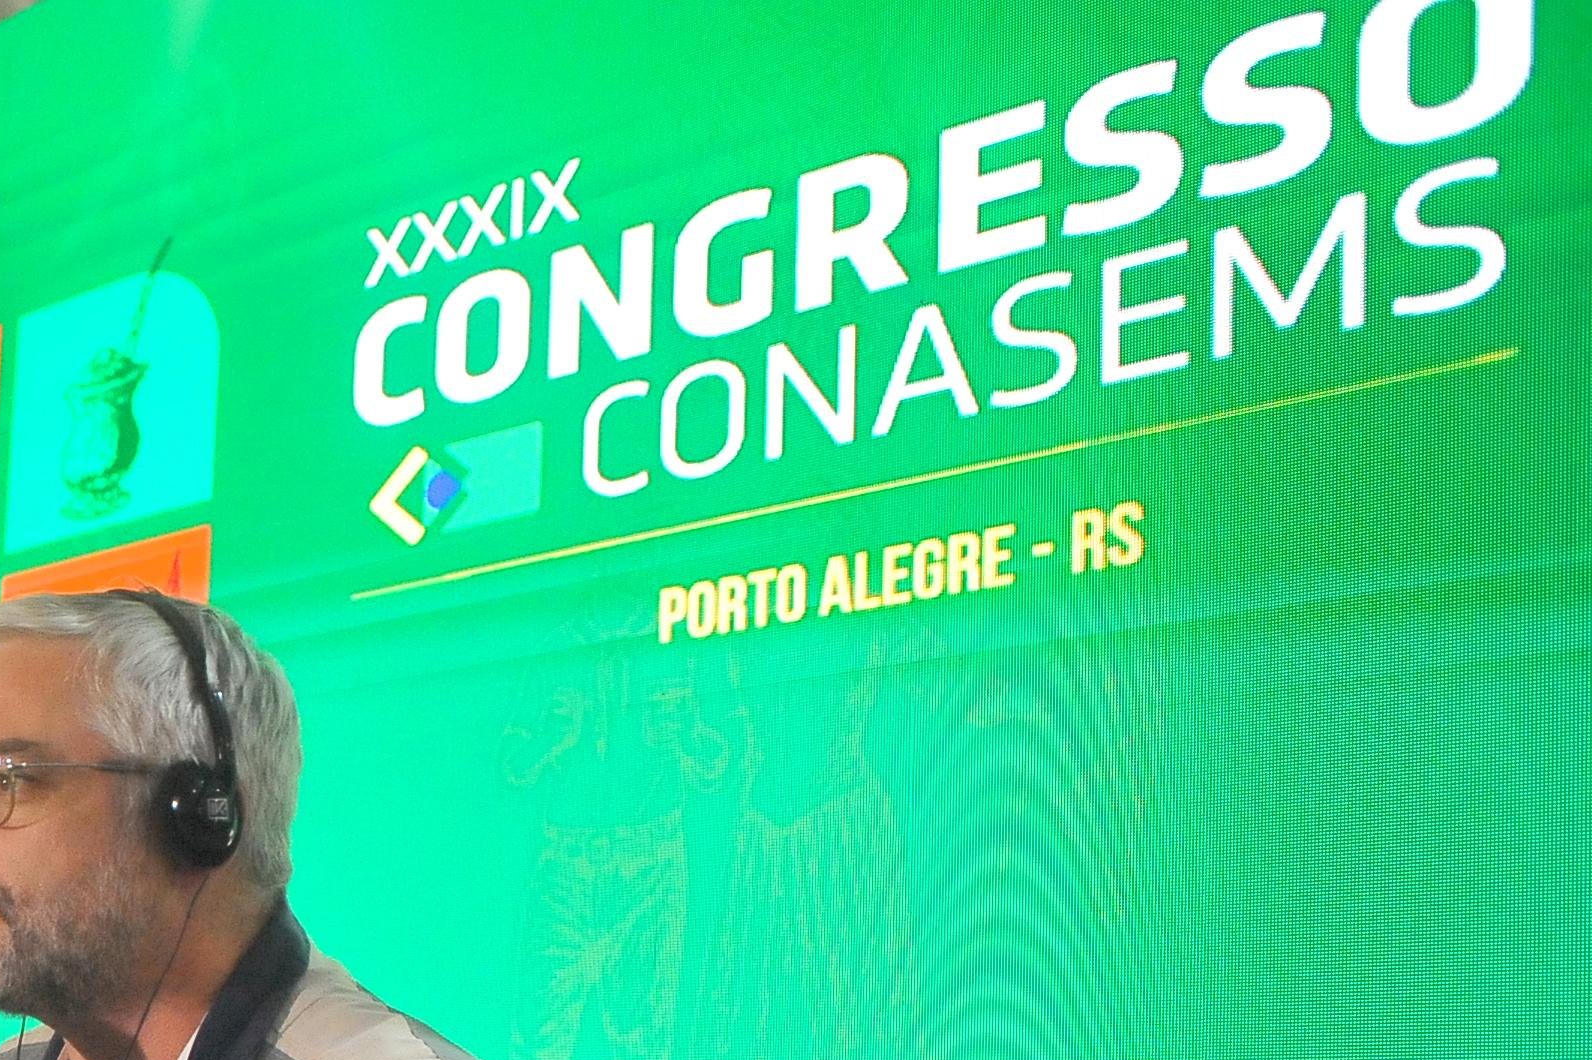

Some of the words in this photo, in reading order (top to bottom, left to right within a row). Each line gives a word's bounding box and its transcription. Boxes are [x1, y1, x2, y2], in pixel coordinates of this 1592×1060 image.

[353, 0, 1533, 426] CONGRESSO
[365, 156, 581, 287] XXXIX
[582, 155, 1507, 497] CONASEMS
[658, 563, 808, 644] PORTO
[818, 523, 1017, 617] ALEGRE
[1070, 500, 1146, 574] RS
